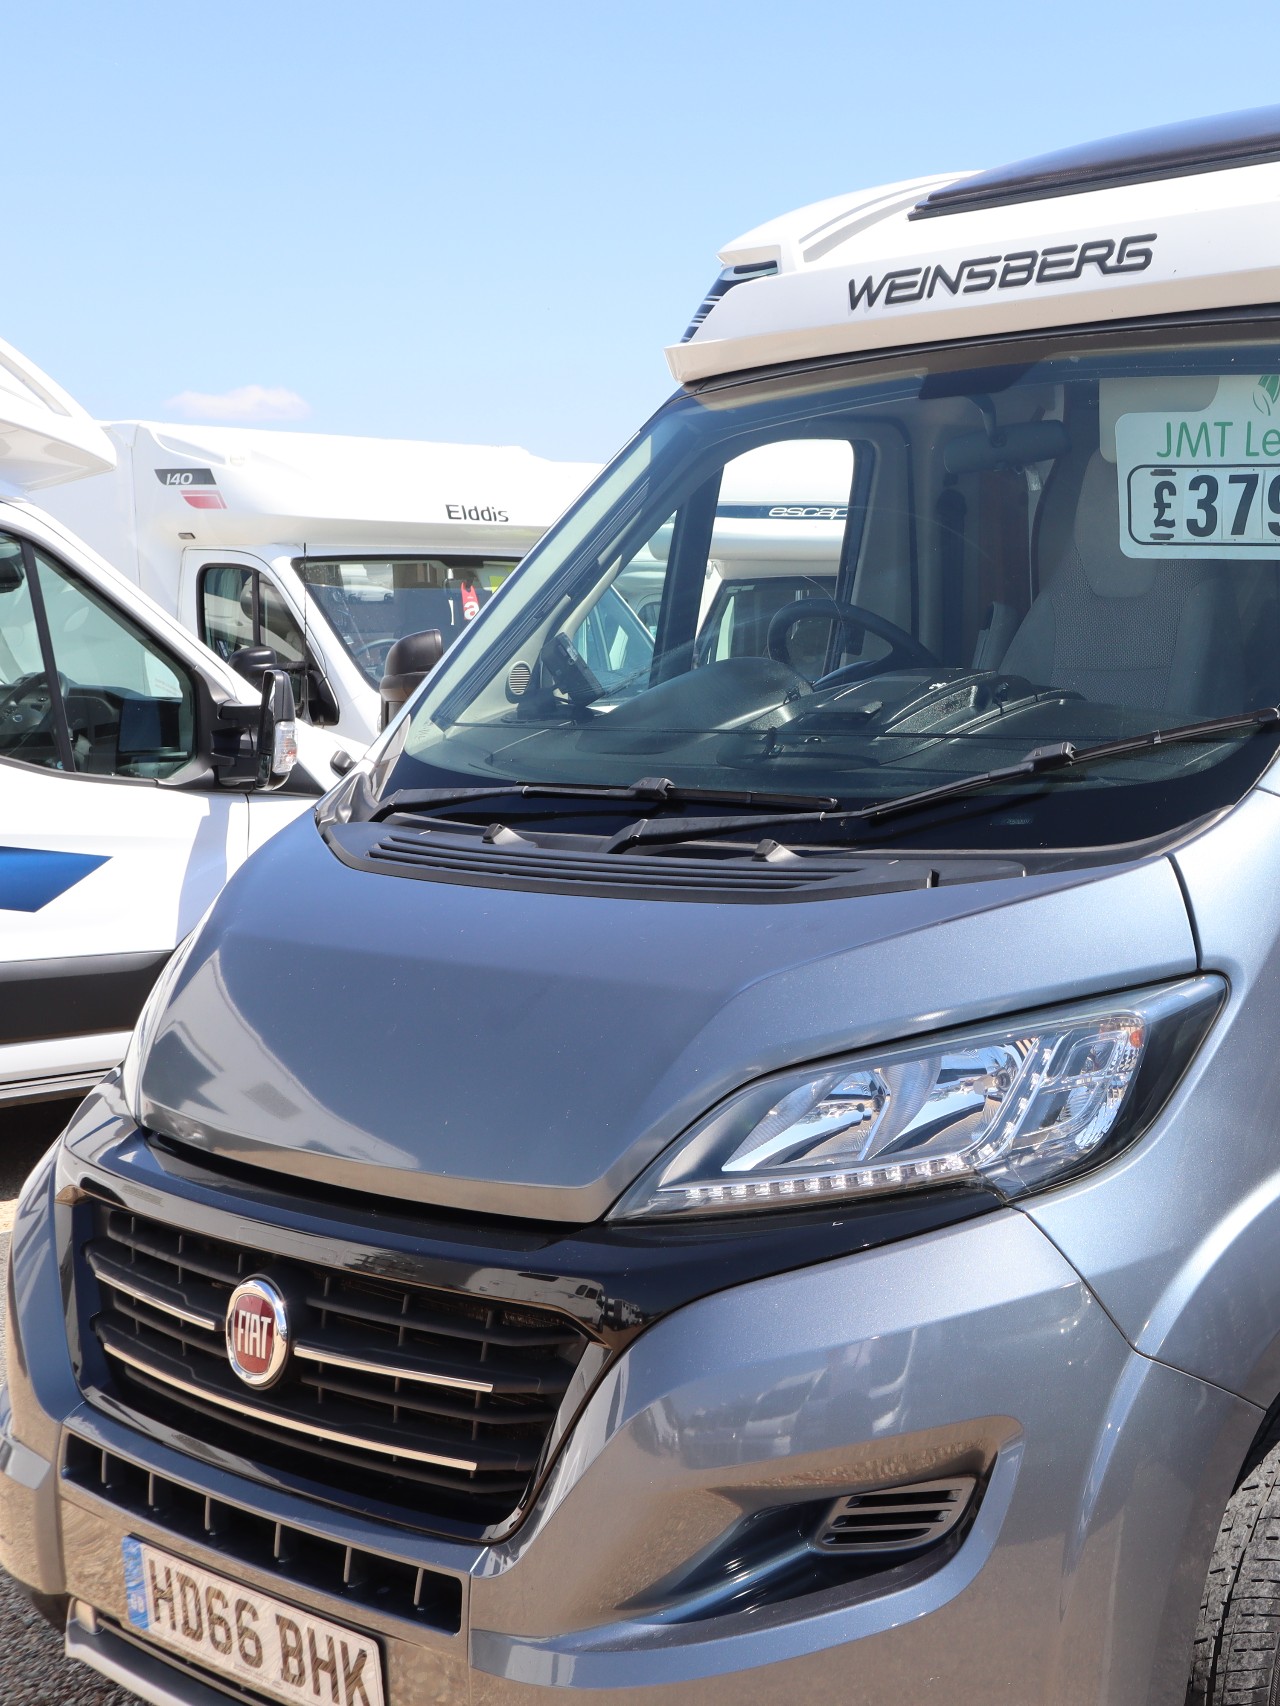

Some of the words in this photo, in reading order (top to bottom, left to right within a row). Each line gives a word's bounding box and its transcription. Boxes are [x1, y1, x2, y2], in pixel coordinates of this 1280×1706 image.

[848, 233, 1157, 311] WEINSBERG
[1156, 421, 1233, 458] JMT
[166, 472, 193, 485] 140
[445, 504, 509, 522] Elddis
[237, 1309, 273, 1360] FIAT
[149, 1558, 264, 1669] HD66
[275, 1612, 371, 1706] BHK
